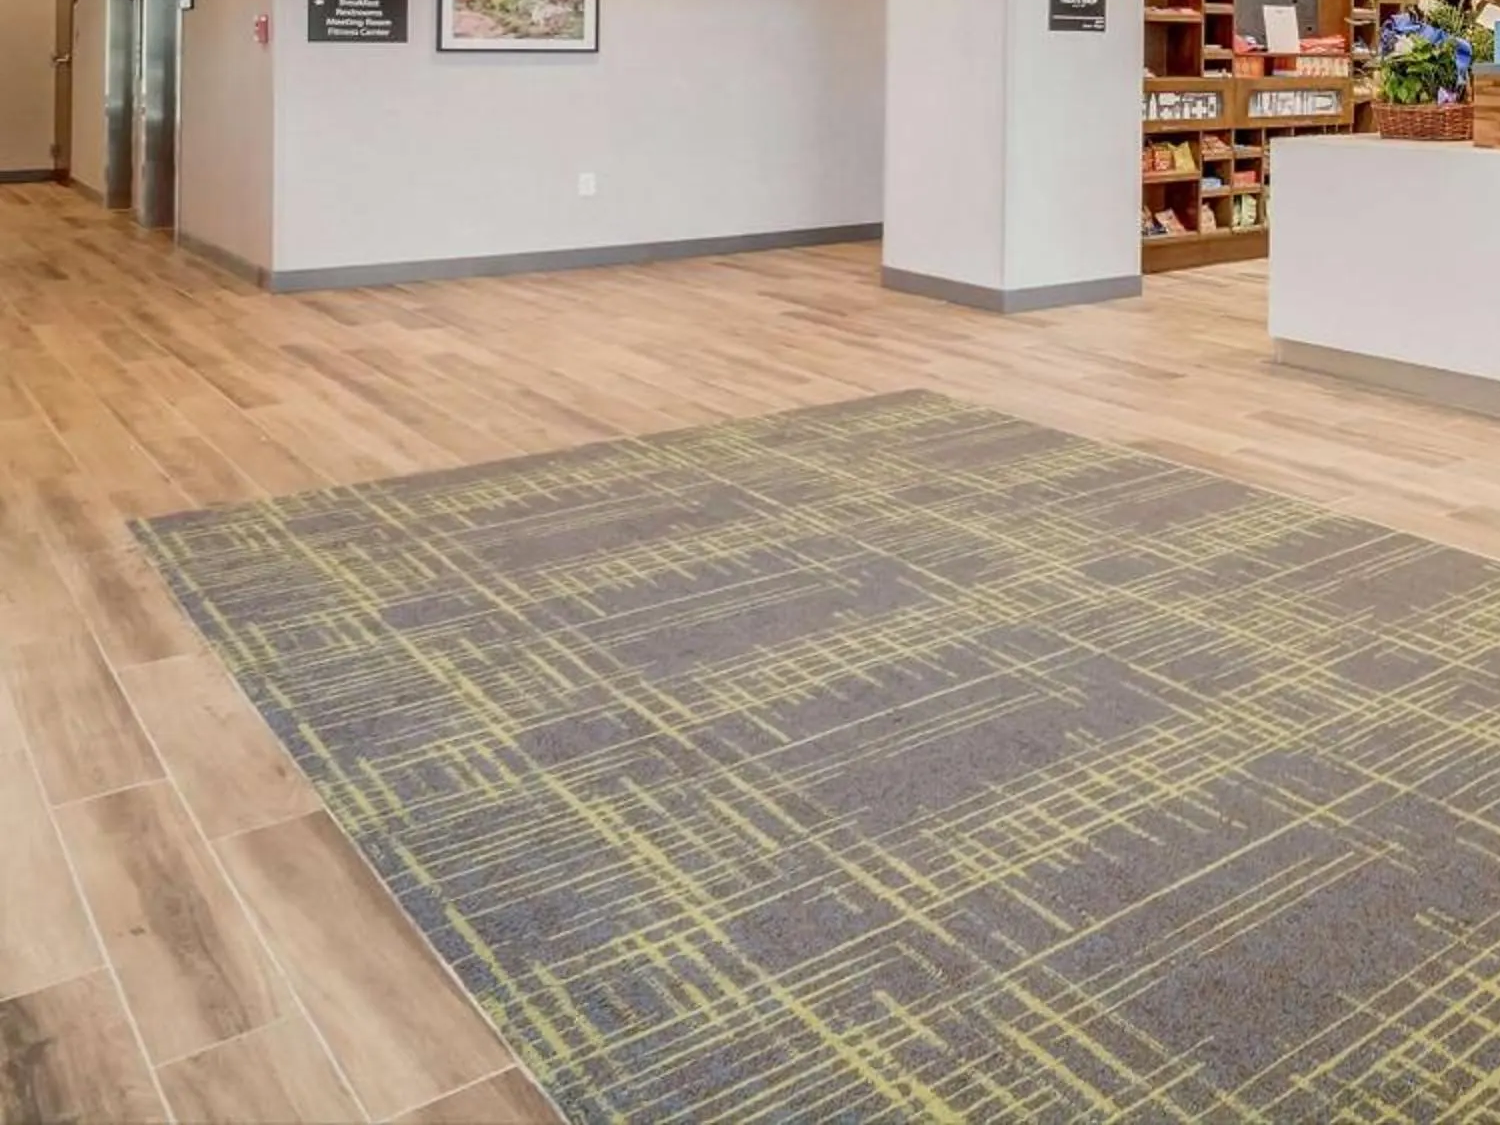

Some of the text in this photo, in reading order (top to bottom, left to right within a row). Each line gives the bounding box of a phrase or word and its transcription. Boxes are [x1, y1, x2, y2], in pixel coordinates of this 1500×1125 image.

[335, 8, 383, 17] Restrooms
[325, 18, 392, 28] Meeting Room
[327, 27, 390, 36] Fitness Center
